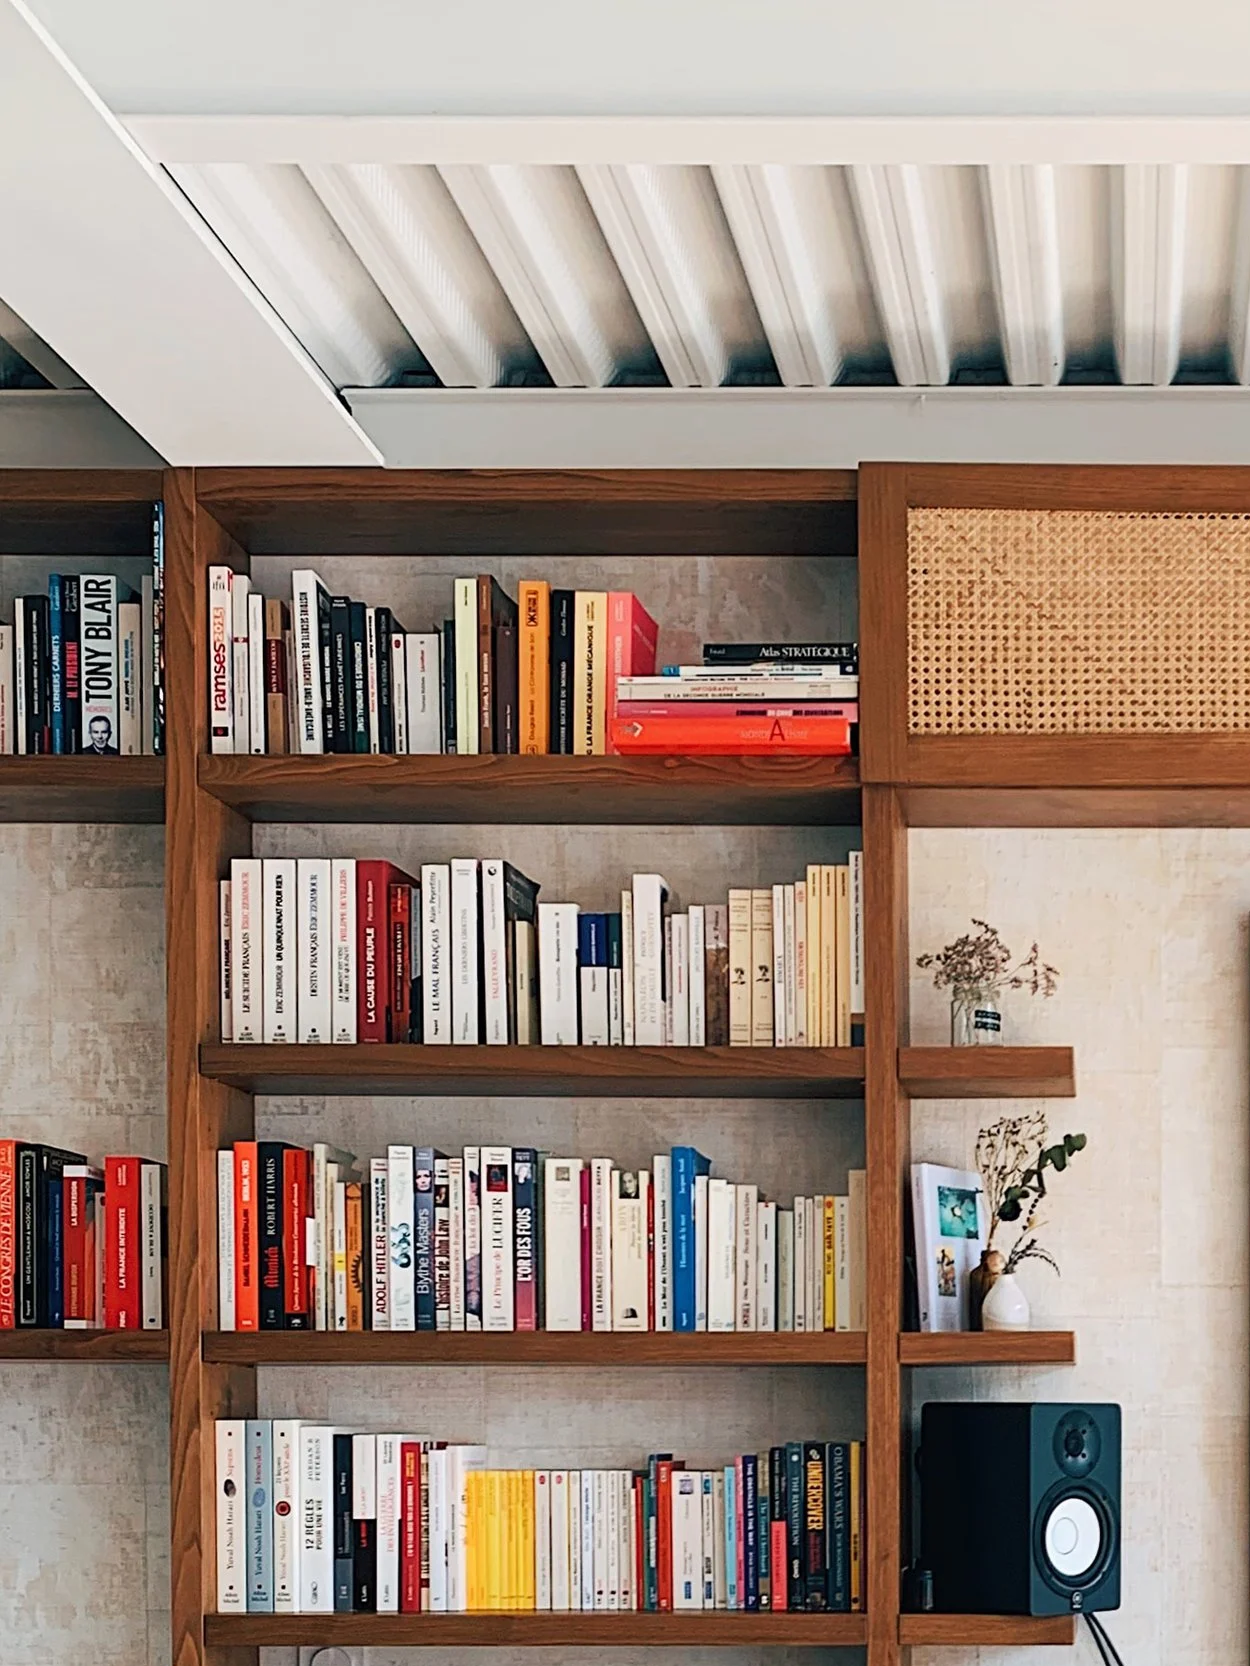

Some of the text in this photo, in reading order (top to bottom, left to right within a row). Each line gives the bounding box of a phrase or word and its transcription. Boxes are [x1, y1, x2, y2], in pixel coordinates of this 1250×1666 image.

[84, 579, 112, 703] TONY BLAIR
[213, 607, 226, 711] ramses 2015
[585, 626, 593, 670] MÉCANIQUE
[760, 647, 780, 657] Atlas
[52, 635, 61, 712] DERNIERS CARNETS
[354, 642, 365, 732] CHRONIQUES DU MONDIALISME
[587, 736, 592, 746] LA
[309, 874, 318, 912] ZEMMOUR
[339, 869, 347, 899] VILLIERS
[340, 901, 347, 910] DE
[429, 872, 437, 923] Alain Peyrefitte
[275, 875, 284, 961] UN QUINQUENNAT POUR RIEN
[242, 932, 251, 1013] LE SUICIDE FRANÇAIS
[309, 933, 319, 997] DESTIN FRANÇAIS
[366, 928, 375, 1023] LA CAUSE DU PEUPLE
[431, 929, 441, 1011] LE MAL FRANÇAIS
[491, 950, 499, 999] TALLEYRAND
[0, 1171, 12, 1215] VIENNE
[267, 1158, 275, 1235] ROBERT HARRIS
[375, 1178, 379, 1186] de
[0, 1217, 12, 1234] DE
[71, 1218, 77, 1226] LA
[516, 1208, 531, 1281] L'OR DES FOUS
[264, 1246, 279, 1287] Munich
[376, 1236, 386, 1313] ADOLF HITLER
[416, 1209, 432, 1293] Blythe Masters
[436, 1219, 449, 1310] L'histoire de John Law
[492, 1198, 503, 1308] Le Principe de LUCIFER
[26, 1275, 31, 1284] UN
[119, 1278, 126, 1288] LA
[0, 1298, 12, 1313] LE
[596, 1304, 603, 1313] LA
[807, 1461, 823, 1530] UNDERCOVER
[834, 1447, 843, 1529] OBAMA'S WARS
[306, 1539, 314, 1549] 12
[380, 1525, 387, 1535] LA
